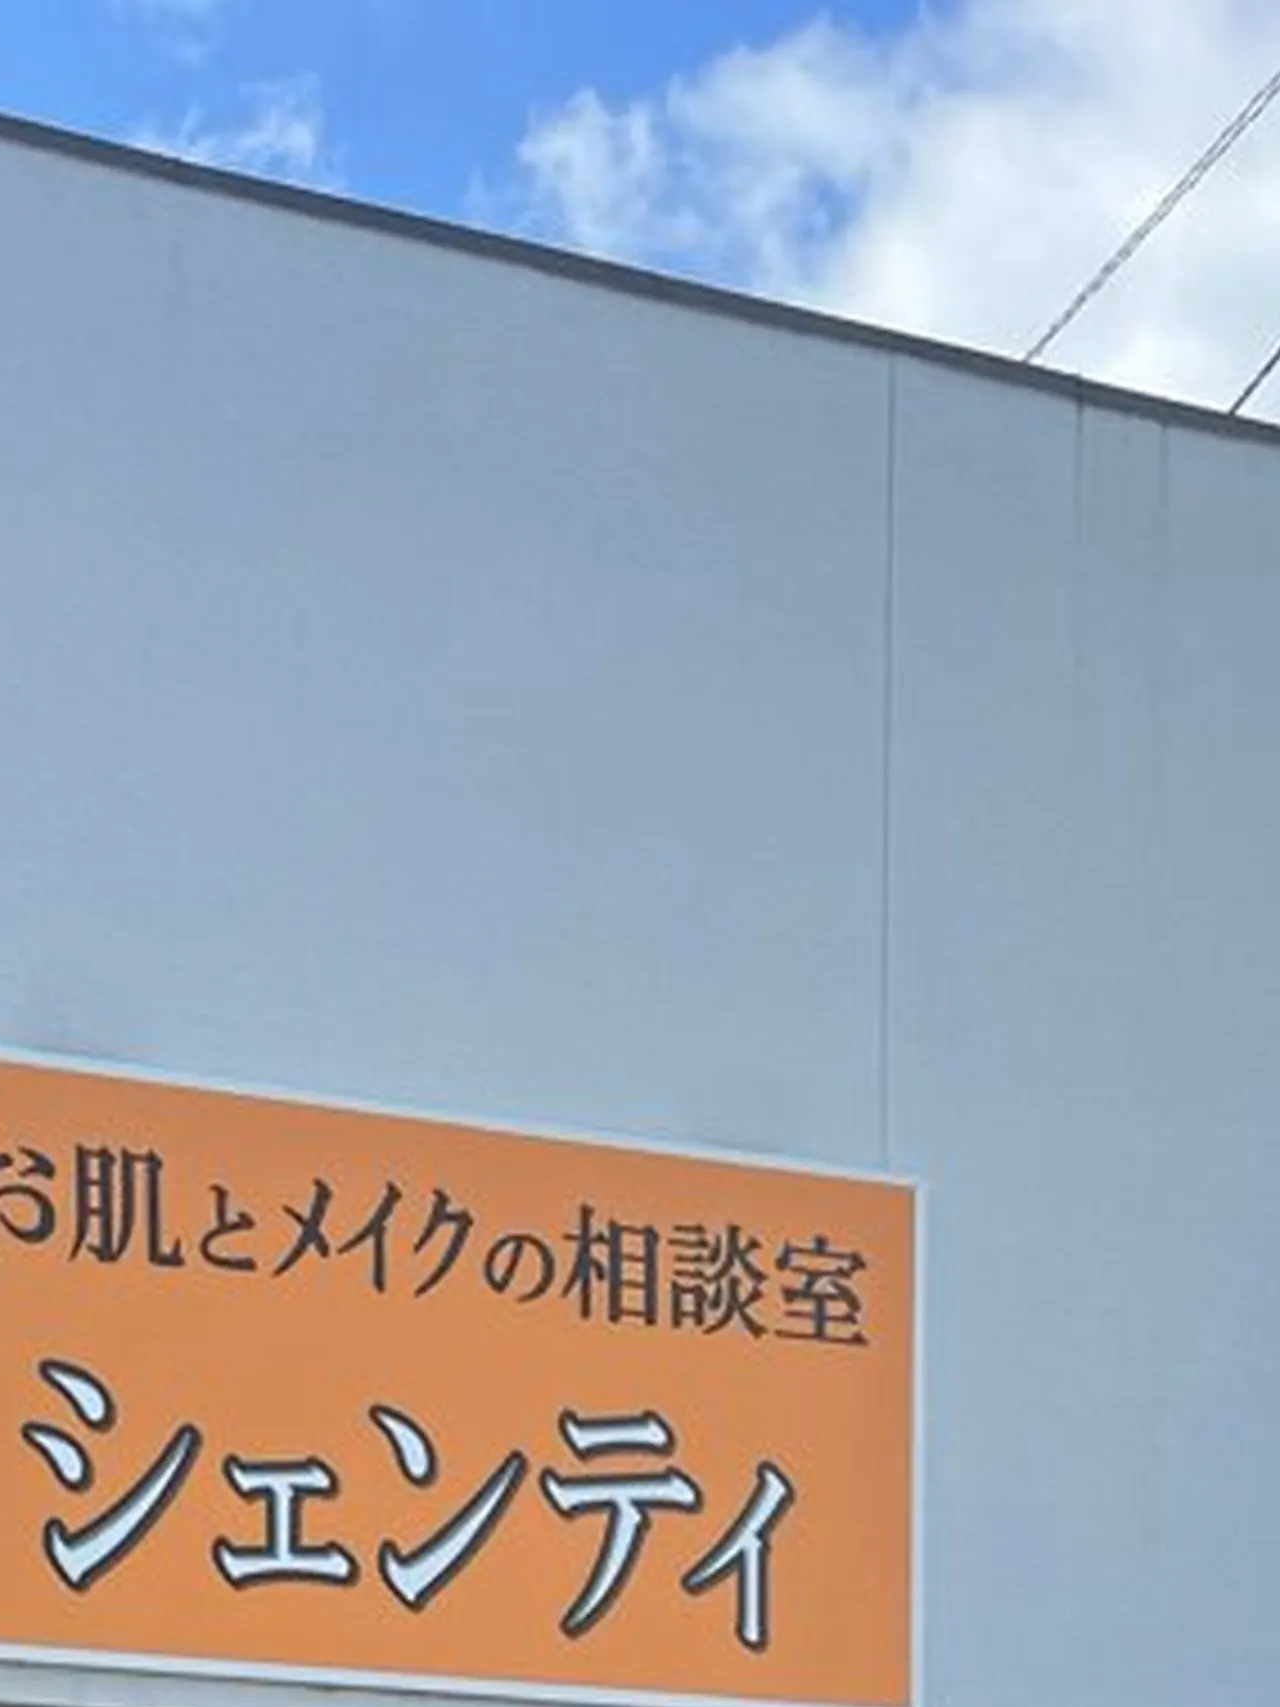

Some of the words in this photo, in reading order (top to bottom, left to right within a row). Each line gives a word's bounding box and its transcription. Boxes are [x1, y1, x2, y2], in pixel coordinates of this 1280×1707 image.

[19, 1356, 797, 1651] シェンティ
